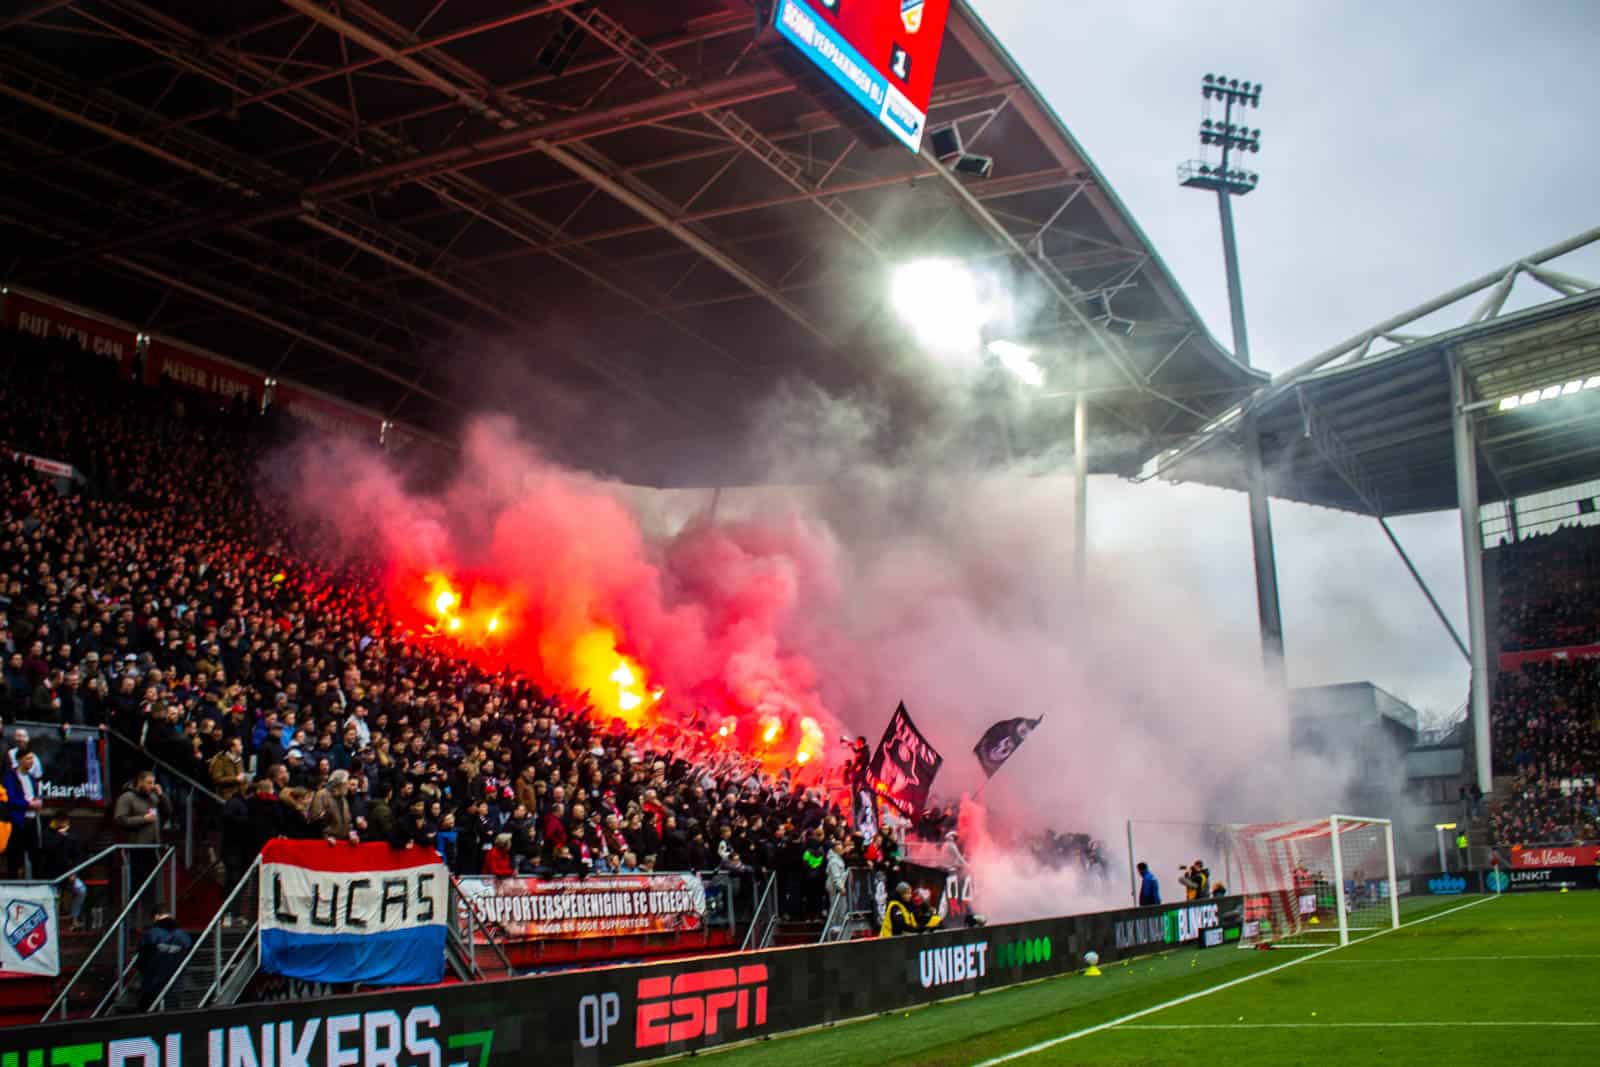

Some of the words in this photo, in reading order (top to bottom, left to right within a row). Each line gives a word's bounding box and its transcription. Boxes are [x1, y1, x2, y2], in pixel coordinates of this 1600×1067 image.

[893, 51, 906, 79] 1
[1510, 870, 1552, 881] LINKIT
[273, 873, 435, 927] LUCAS
[477, 891, 632, 923] SUPPORTERSVERENIGING
[633, 890, 649, 915] FC
[919, 942, 988, 988] UNIBET
[578, 991, 621, 1047] OP
[635, 964, 769, 1049] ESPN
